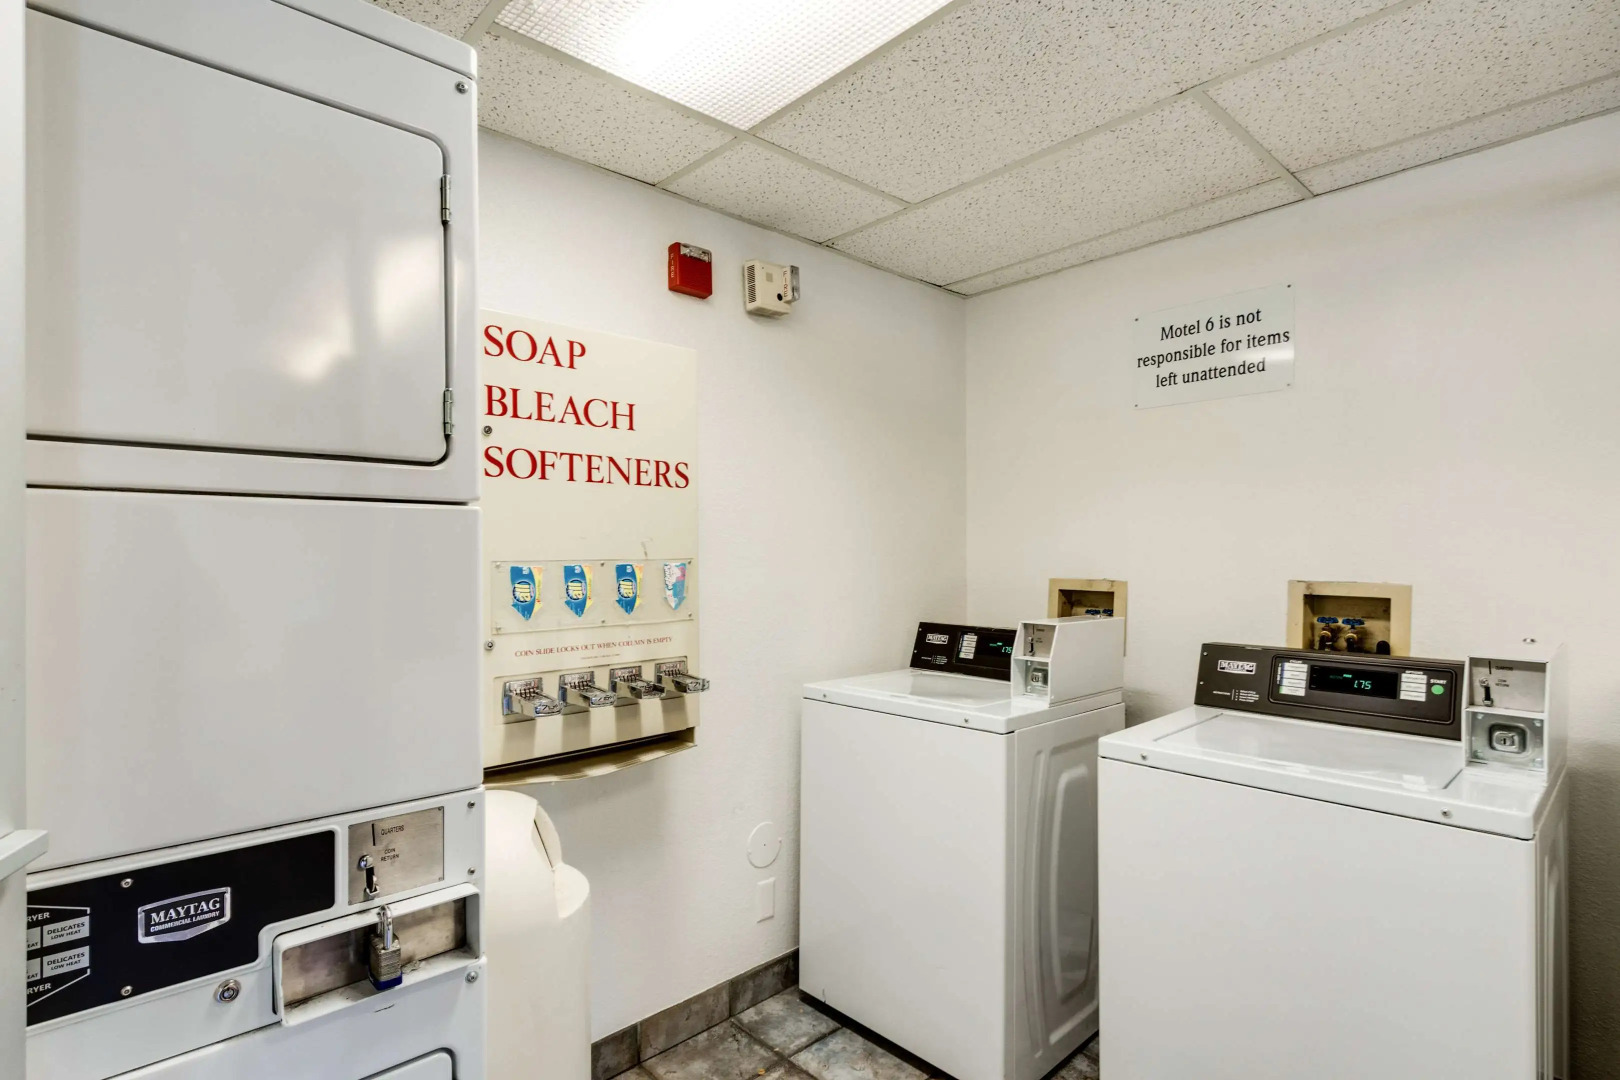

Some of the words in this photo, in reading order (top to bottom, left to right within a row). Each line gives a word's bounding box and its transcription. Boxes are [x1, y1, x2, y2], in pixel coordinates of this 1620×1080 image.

[1160, 320, 1201, 341] Motel
[1205, 317, 1214, 331] 6
[1219, 315, 1231, 329] is
[1236, 308, 1262, 326] not
[483, 324, 587, 370] SOAP
[1137, 342, 1216, 368] responsible
[1221, 338, 1242, 354] for
[1247, 330, 1290, 349] items
[1156, 371, 1178, 388] left
[1182, 357, 1266, 384] unattended
[484, 384, 636, 431] BLEACH
[483, 445, 690, 489] SOFTENERS
[514, 650, 535, 658] COIN
[535, 647, 555, 655] SLIDE
[556, 645, 580, 654] LOCKS
[580, 643, 596, 651] OUT
[617, 639, 646, 648] COLUMN
[653, 636, 673, 644] EMPTY
[380, 824, 405, 836] QUARTERS
[380, 853, 400, 861] RETURN
[150, 898, 220, 925] MAYTAG
[150, 918, 192, 933] COMMERCIAL
[192, 910, 220, 923] LAUNDRY
[46, 921, 85, 935] DELICATES
[65, 929, 82, 937] HEAT
[46, 952, 85, 966] DELICATES
[50, 963, 65, 971] LOW
[65, 960, 82, 968] HEAT
